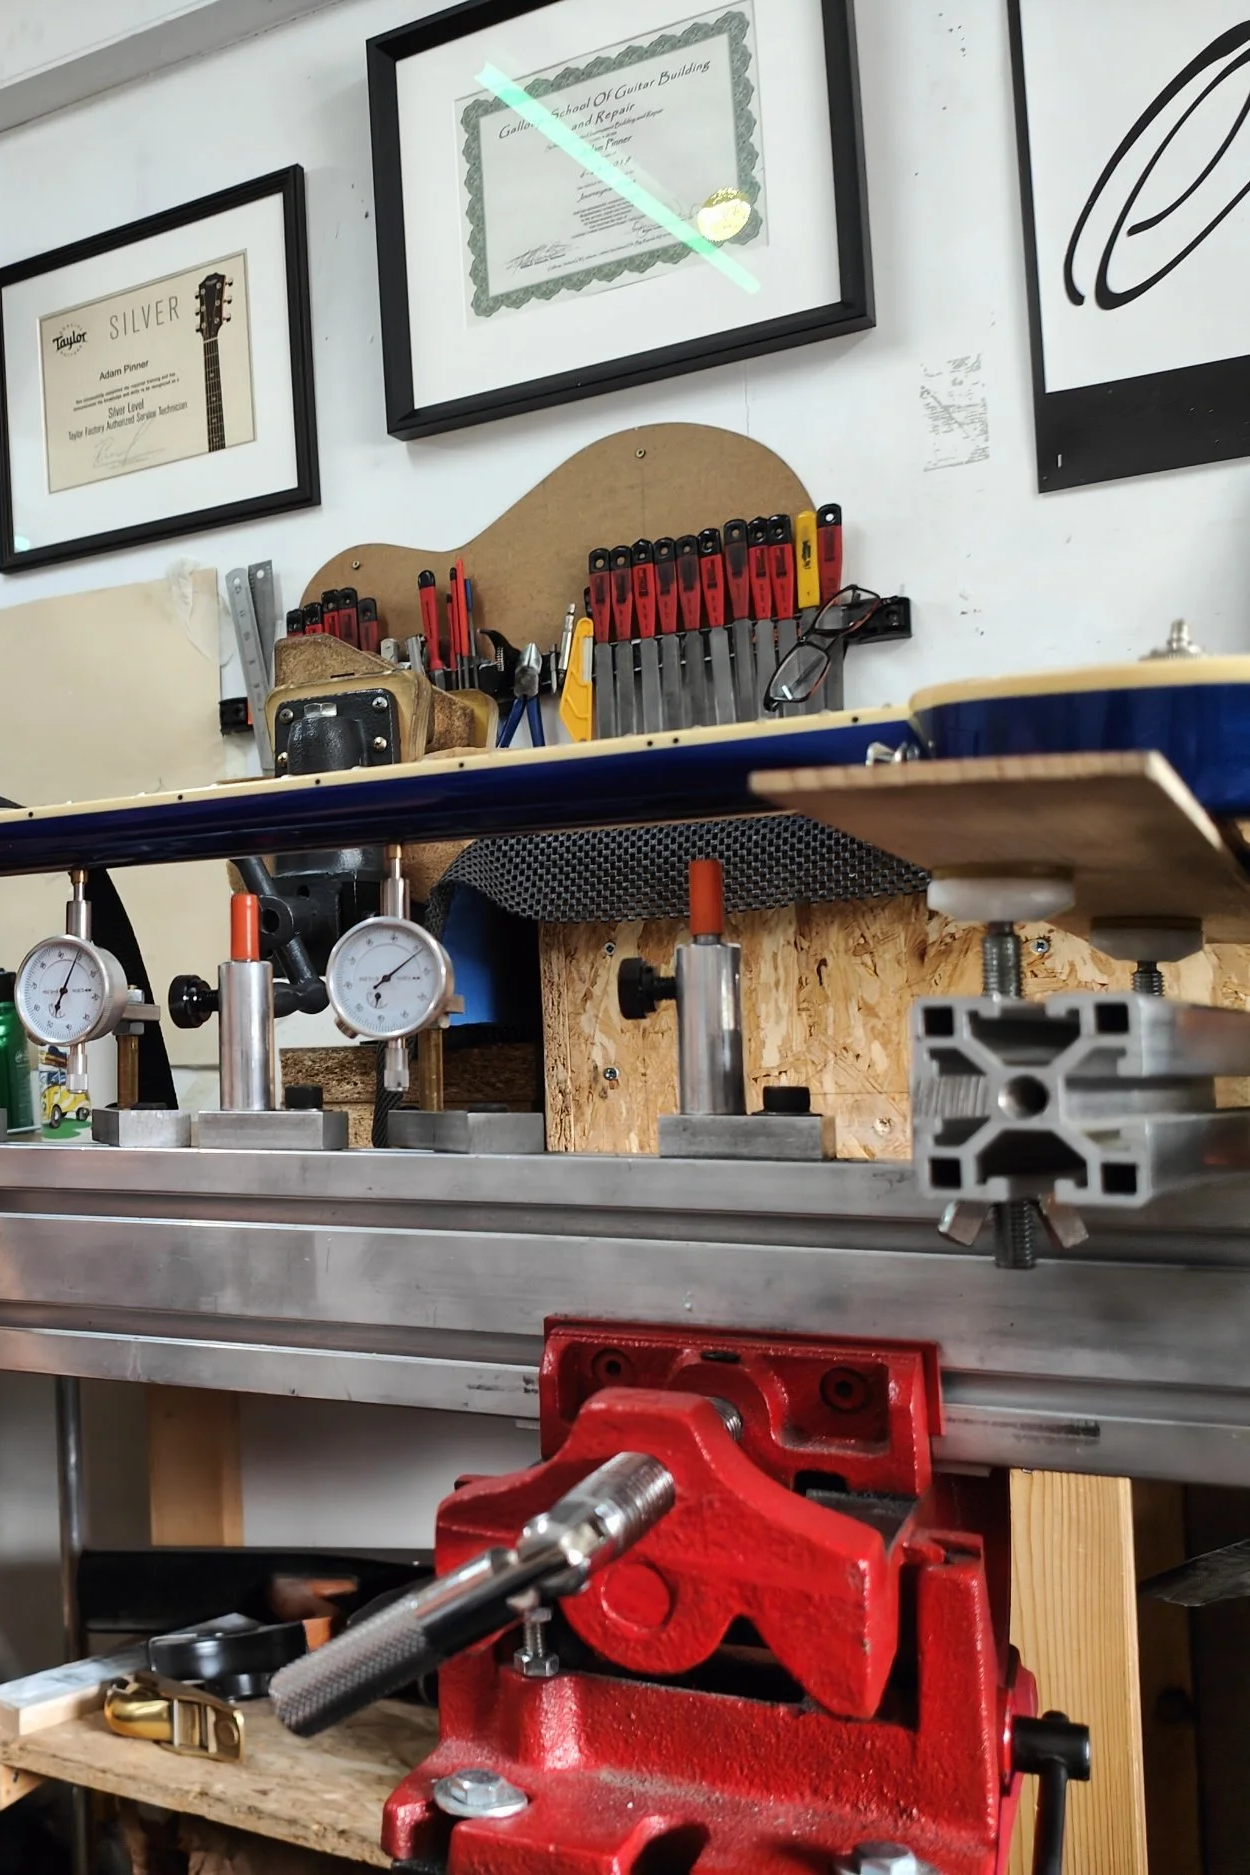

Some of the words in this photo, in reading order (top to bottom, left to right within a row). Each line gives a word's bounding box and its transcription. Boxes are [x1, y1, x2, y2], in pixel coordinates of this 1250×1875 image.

[550, 97, 591, 120] School
[593, 86, 613, 108] Of
[614, 78, 655, 101] Guitar
[657, 60, 711, 86] Building
[571, 114, 593, 131] and
[595, 102, 636, 124] Repair
[110, 295, 180, 340] SILVER
[52, 330, 88, 351] Taylor
[99, 367, 122, 380] Adam
[123, 360, 149, 374] Pinner
[108, 405, 125, 419] Silver
[127, 398, 144, 413] Level
